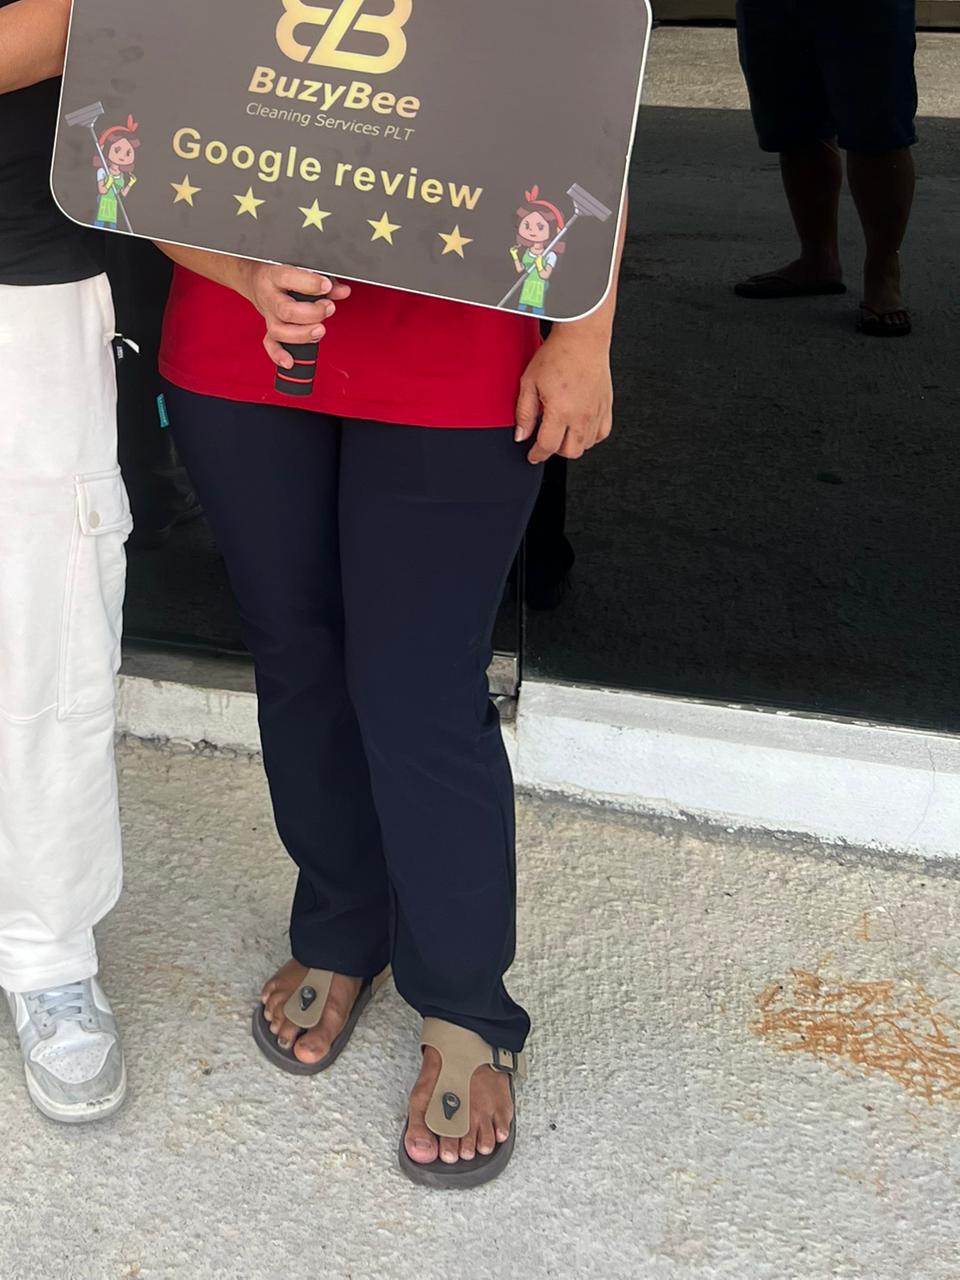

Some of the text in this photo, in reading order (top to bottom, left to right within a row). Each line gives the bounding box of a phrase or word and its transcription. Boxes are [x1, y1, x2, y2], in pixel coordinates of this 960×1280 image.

[247, 66, 421, 119] BuzyBee
[246, 102, 416, 141] Cleaning Services PLT
[172, 127, 484, 210] Google review
